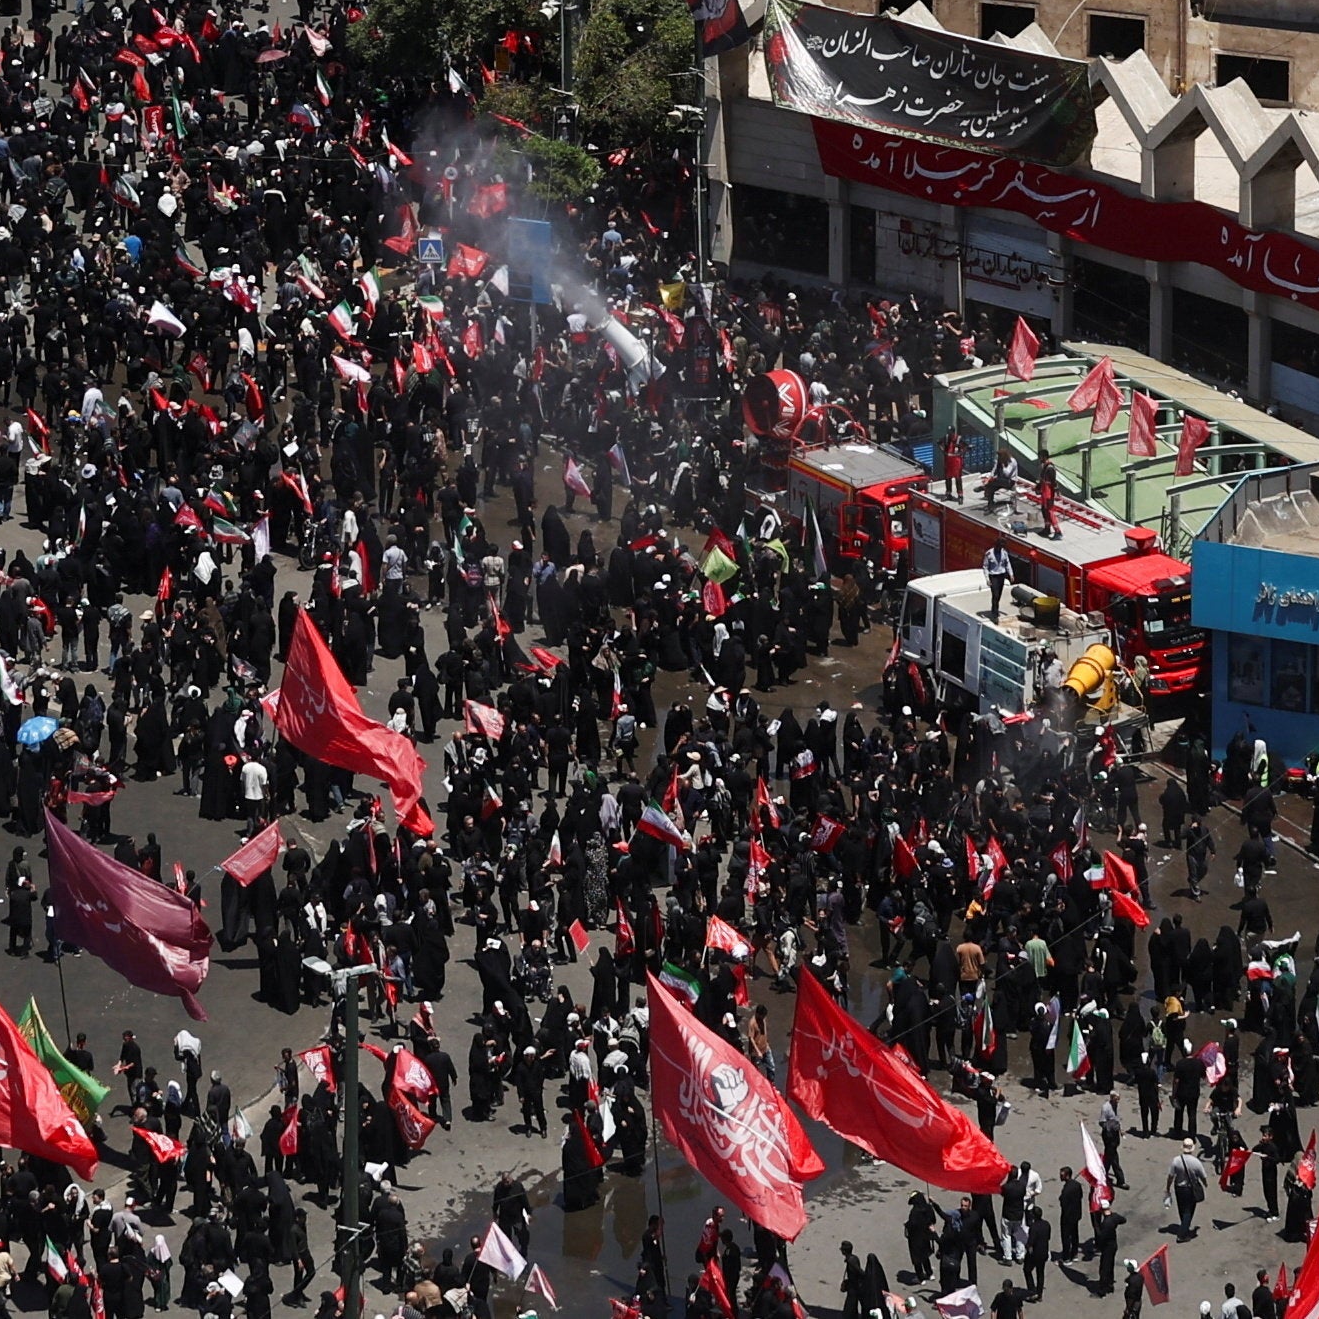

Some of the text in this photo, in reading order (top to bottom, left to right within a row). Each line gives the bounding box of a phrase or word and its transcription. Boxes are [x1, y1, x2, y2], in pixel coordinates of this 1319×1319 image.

[821, 27, 874, 60] الزمان
[870, 43, 932, 72] صاحب
[929, 44, 977, 79] نثاران
[832, 79, 908, 113] زهرا
[974, 63, 1006, 96] جان
[904, 89, 966, 127] حضرت
[851, 132, 903, 174] آمده
[1071, 187, 1101, 229] از
[1220, 225, 1265, 272] آمده
[1255, 581, 1277, 606] زائر
